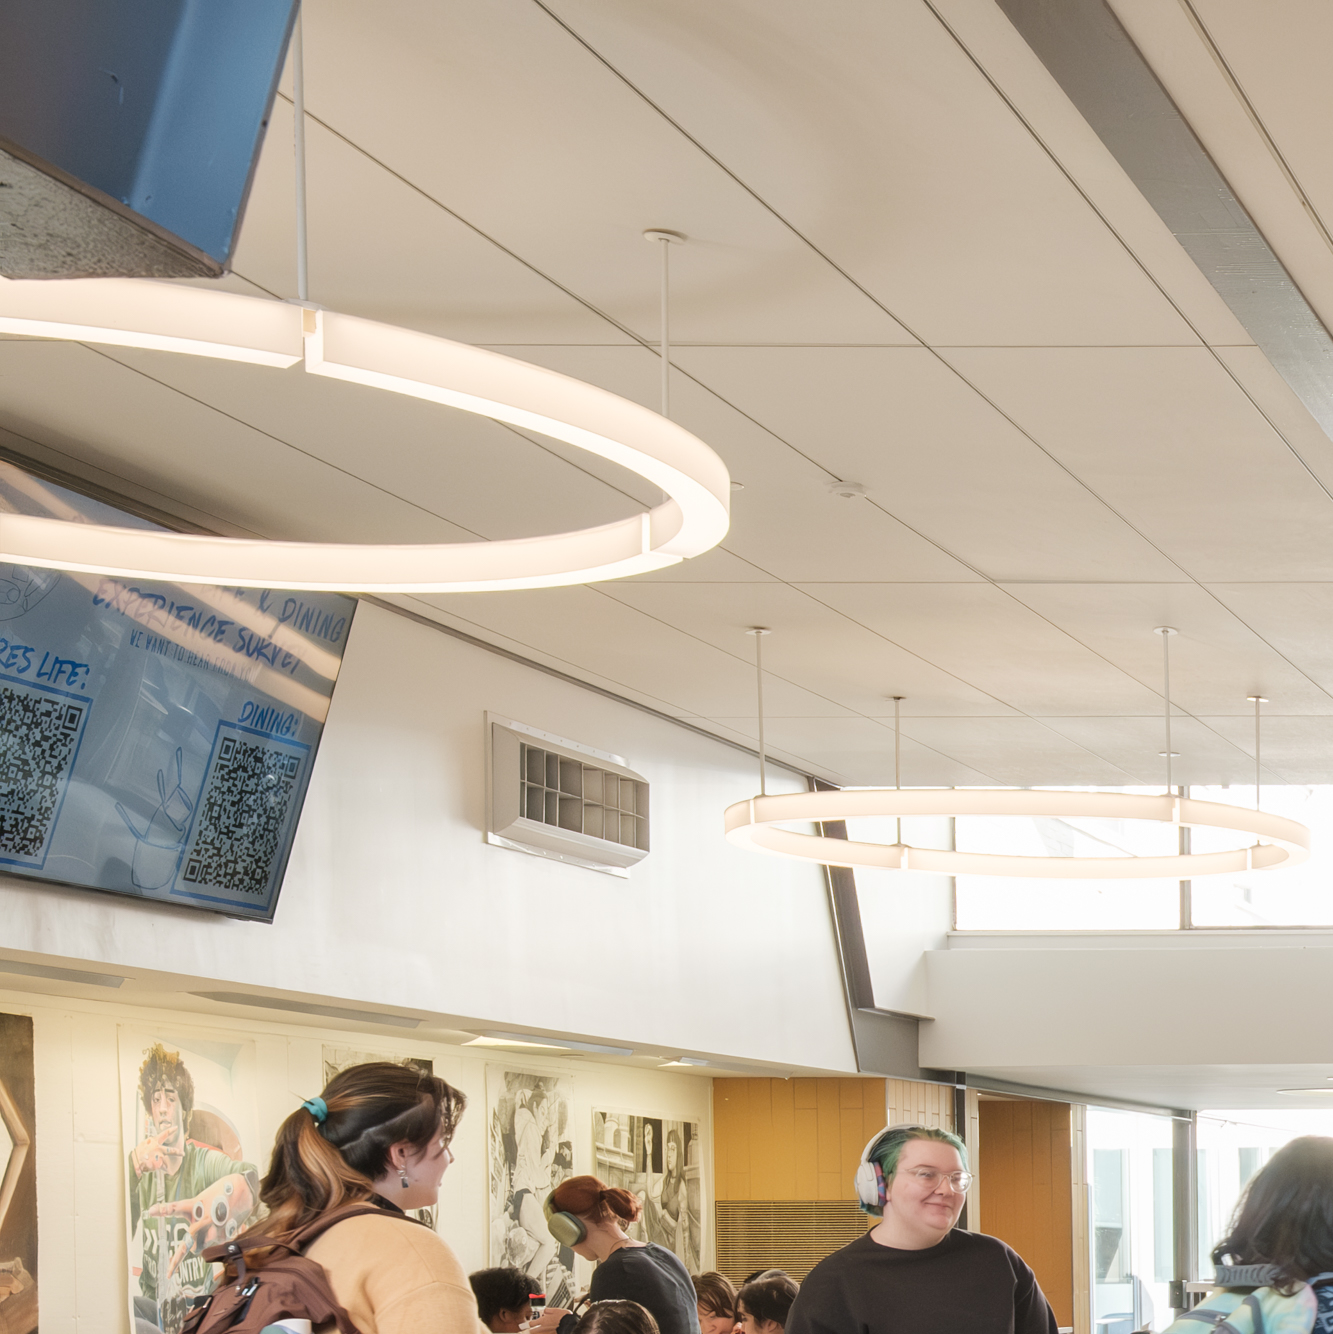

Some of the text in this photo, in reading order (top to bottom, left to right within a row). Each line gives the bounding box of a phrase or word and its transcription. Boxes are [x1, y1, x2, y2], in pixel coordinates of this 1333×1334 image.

[92, 579, 236, 644] EXPERIENCE
[280, 598, 347, 643] DINING
[129, 628, 143, 649] WE
[145, 634, 172, 657] WANT
[36, 651, 90, 690] LIFE:
[238, 700, 299, 738] DINING:
